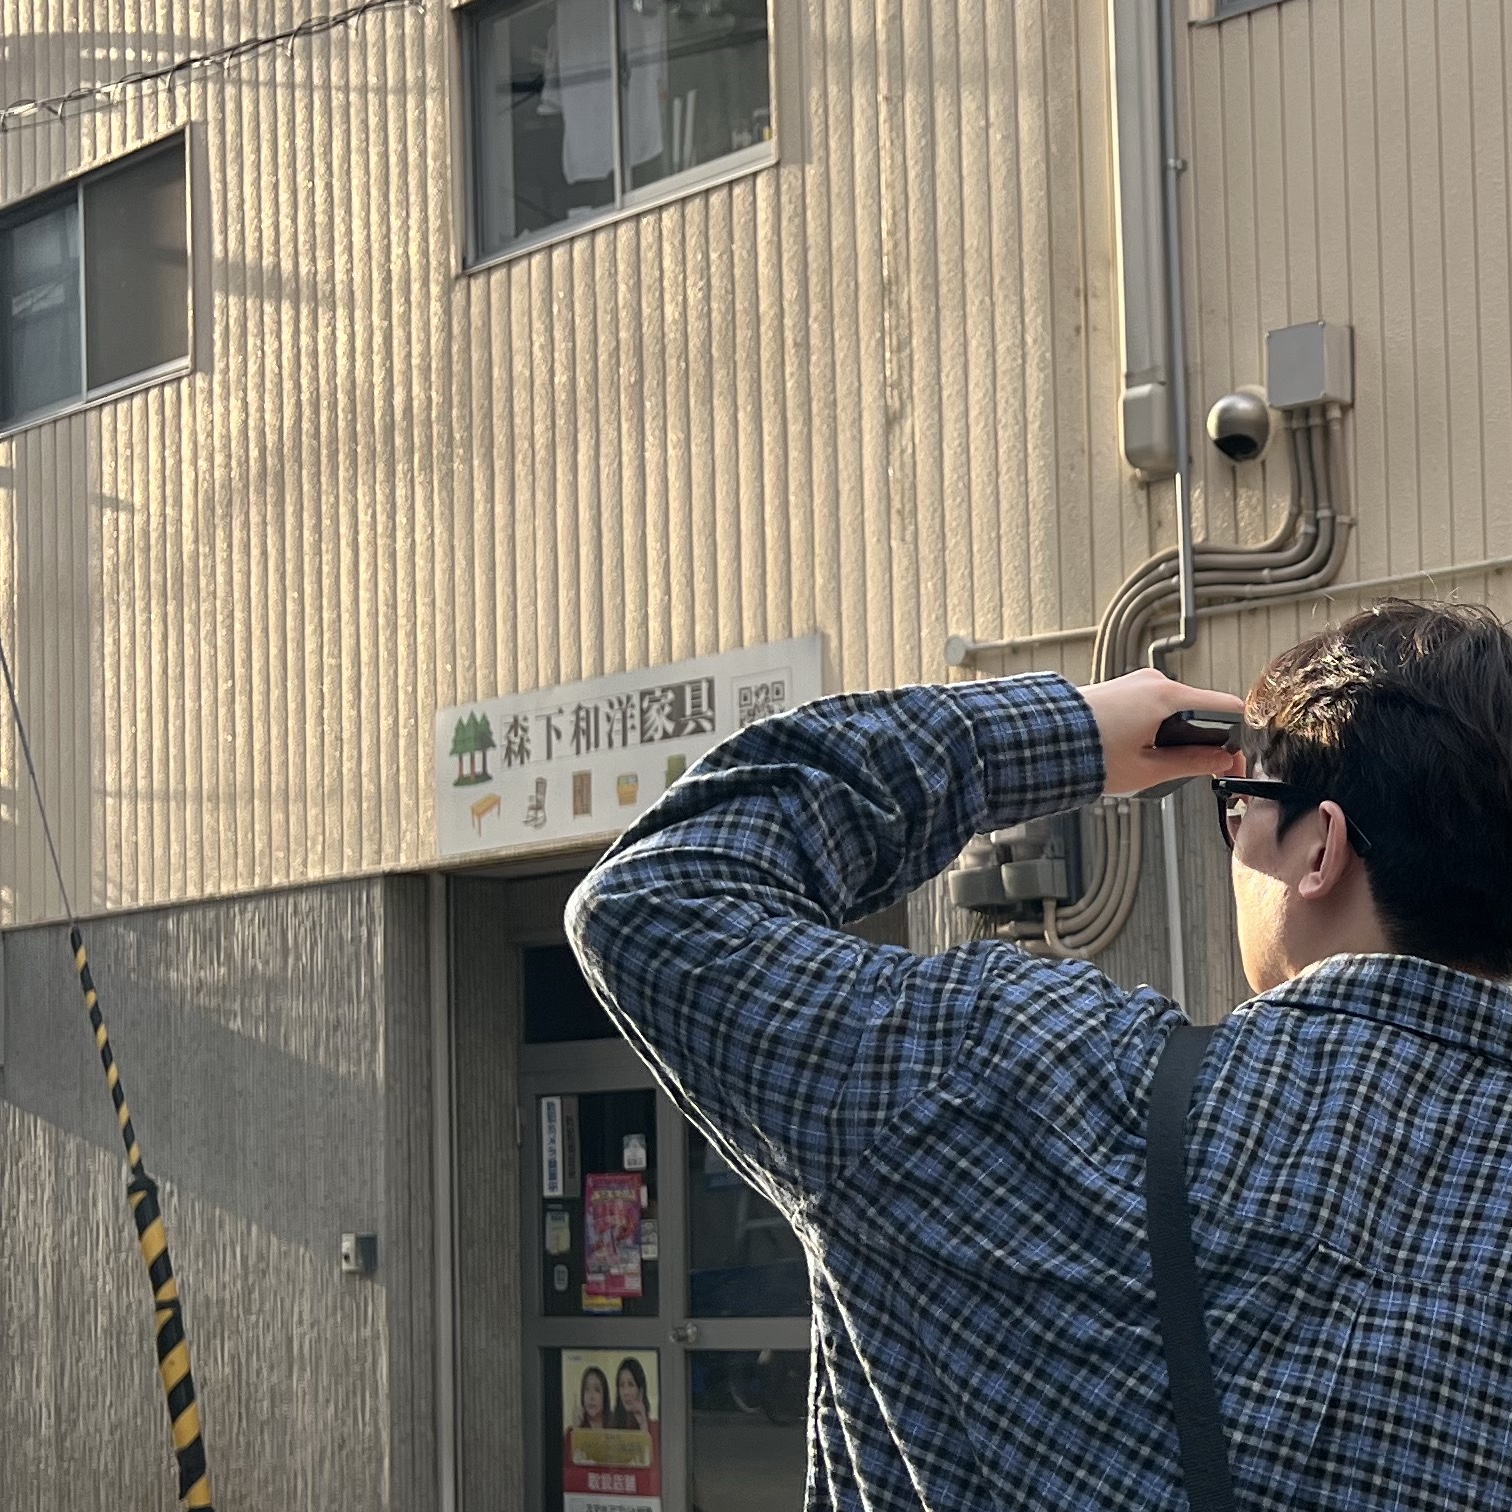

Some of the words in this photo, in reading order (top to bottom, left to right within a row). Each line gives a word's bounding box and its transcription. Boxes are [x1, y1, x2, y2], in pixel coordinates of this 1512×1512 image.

[502, 675, 716, 768] 森下和洋家具
